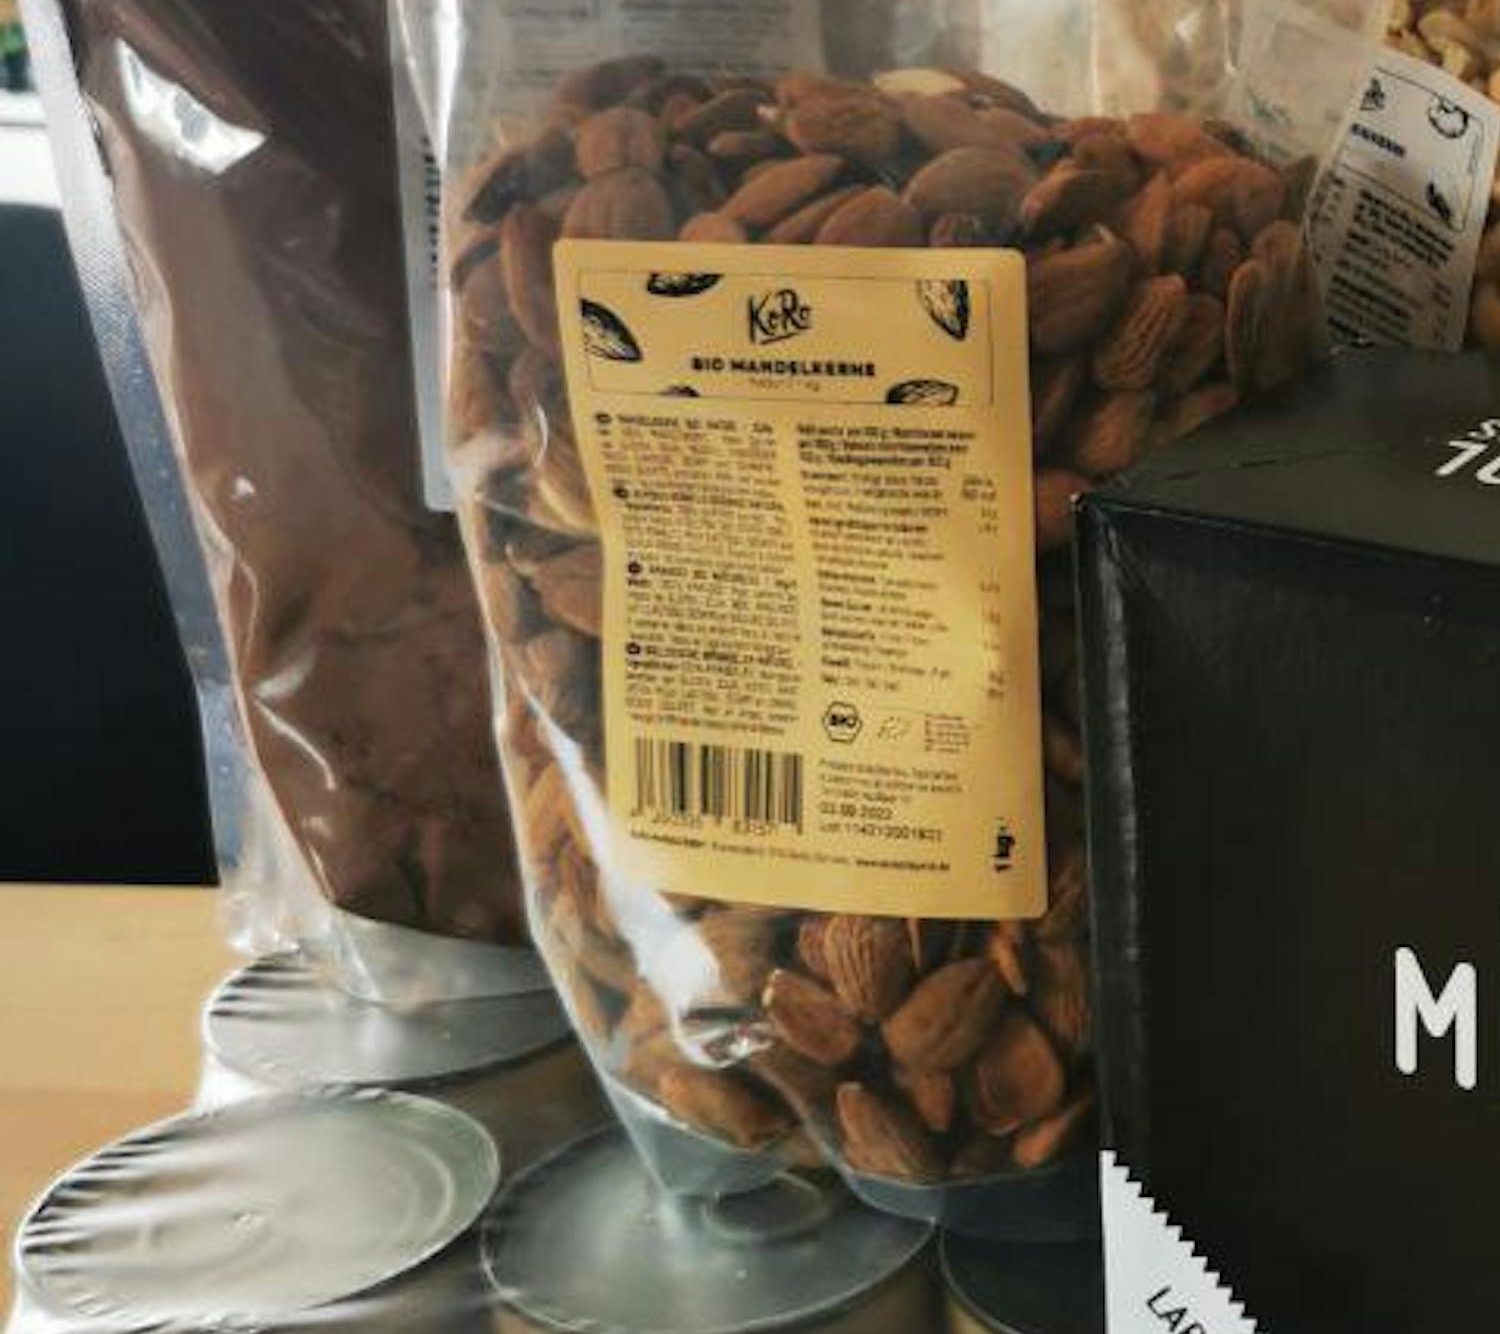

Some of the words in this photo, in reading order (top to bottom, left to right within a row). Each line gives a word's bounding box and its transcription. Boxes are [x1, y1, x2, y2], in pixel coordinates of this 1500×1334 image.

[747, 287, 812, 346] KoRo
[691, 356, 722, 371] BIO
[729, 357, 876, 378] MANDELKERNE
